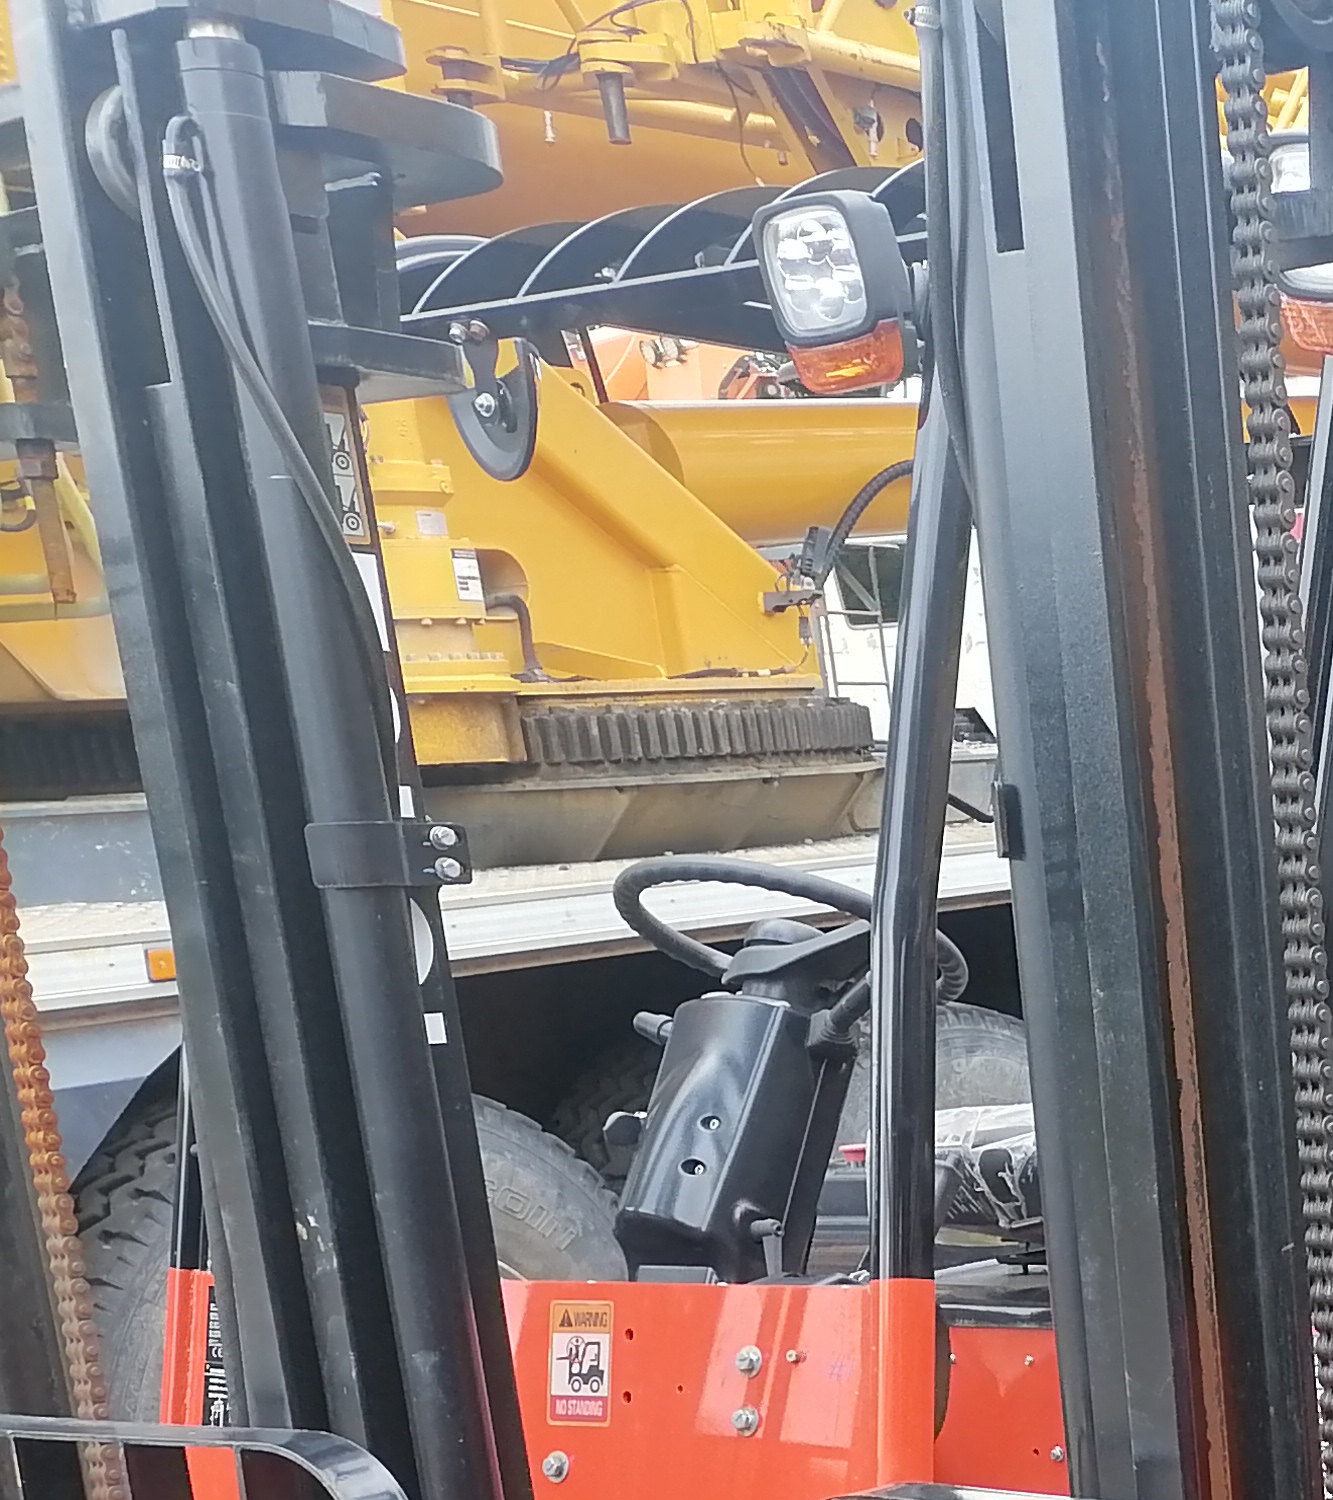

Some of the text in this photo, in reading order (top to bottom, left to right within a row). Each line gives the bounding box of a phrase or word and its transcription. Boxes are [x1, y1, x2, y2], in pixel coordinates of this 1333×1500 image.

[573, 1311, 608, 1328] WARNING
[555, 1399, 603, 1416] NO STANDING
